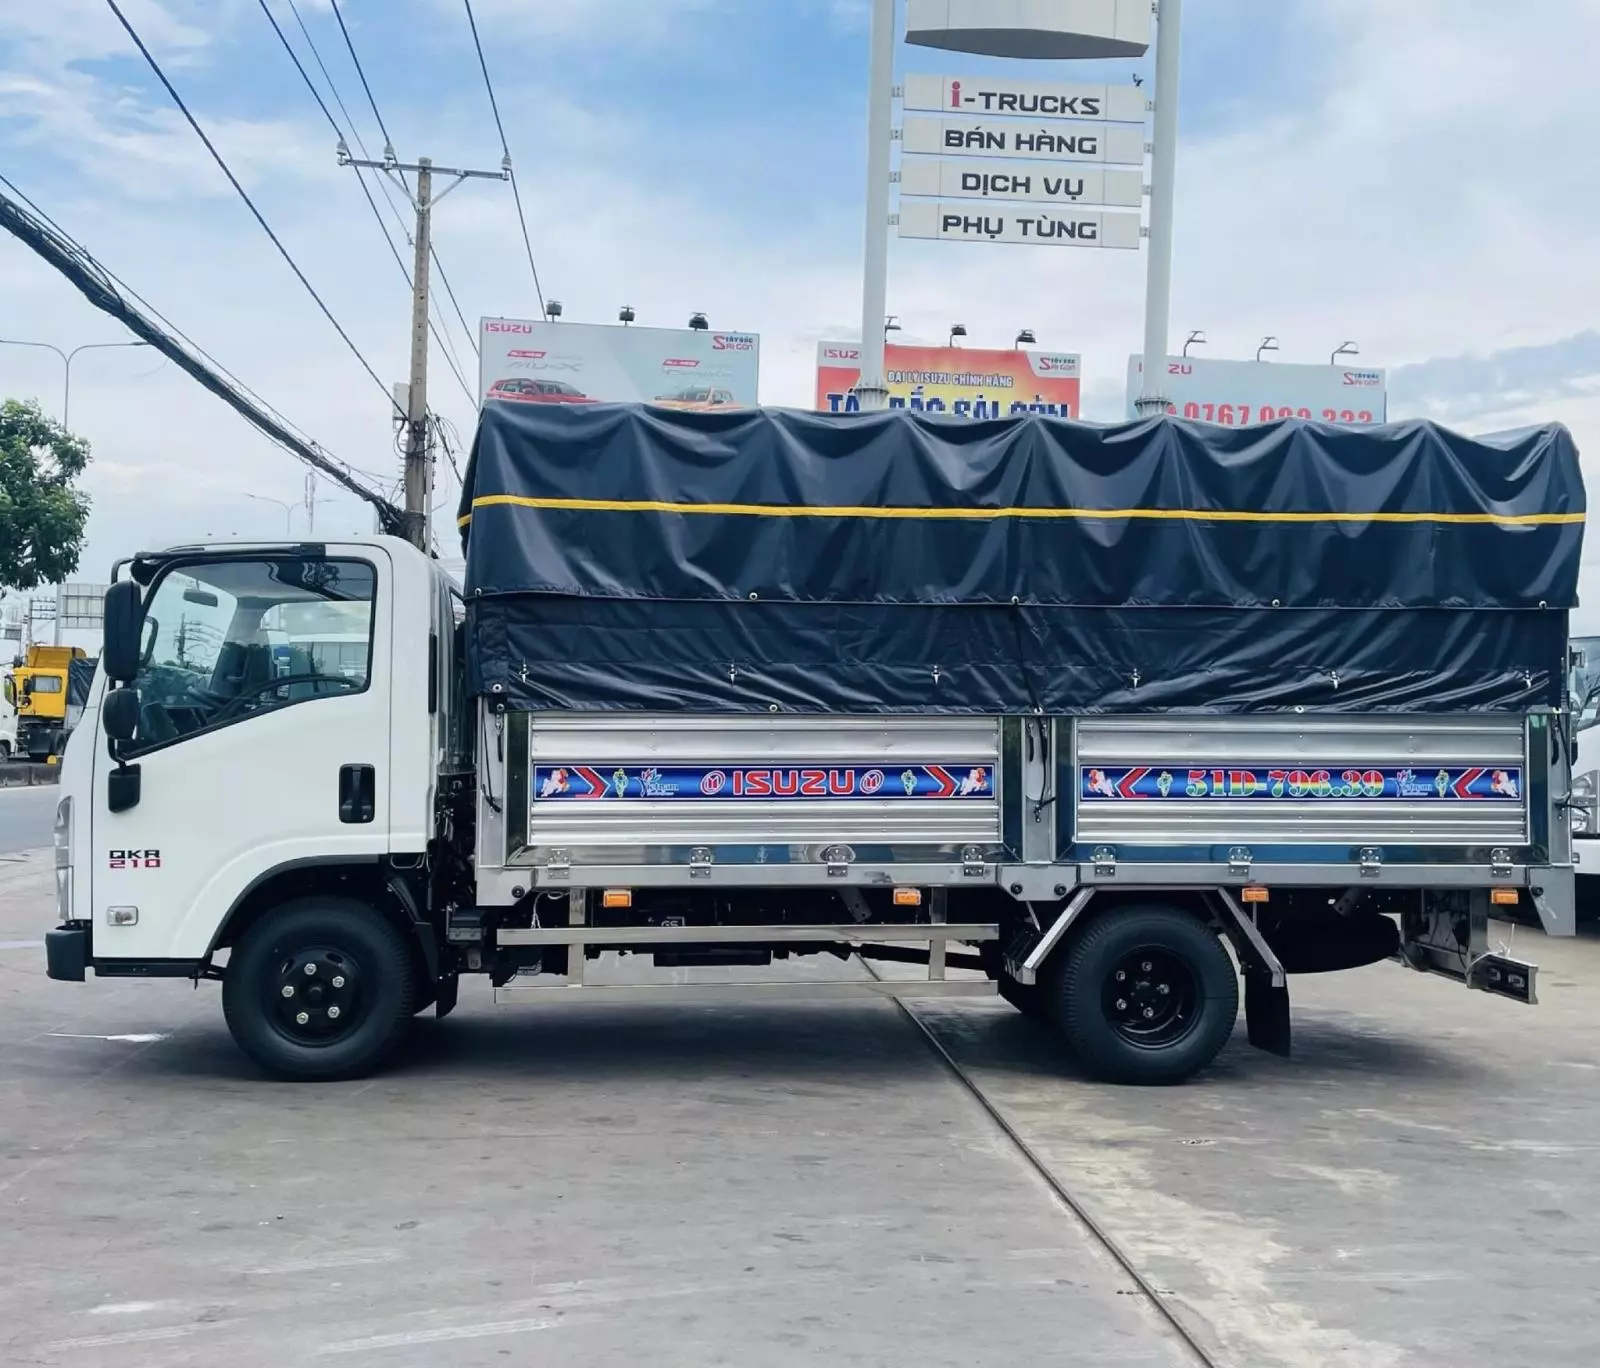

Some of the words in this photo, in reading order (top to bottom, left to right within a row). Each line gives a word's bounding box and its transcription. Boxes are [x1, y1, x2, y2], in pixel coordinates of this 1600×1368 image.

[951, 80, 1100, 116] i-TRUCKS
[944, 126, 1006, 150] BÁN
[1014, 129, 1097, 154] HÀNG
[961, 173, 1031, 196] DỊCH
[1043, 176, 1084, 200] VỤ
[942, 214, 1004, 239] PHỤ
[1016, 215, 1097, 239] TÙNG
[485, 322, 533, 334] ISUZU
[824, 349, 862, 359] ISUZ
[920, 372, 951, 384] ISUZU
[733, 770, 854, 795] ISUZU
[109, 859, 161, 869] 210
